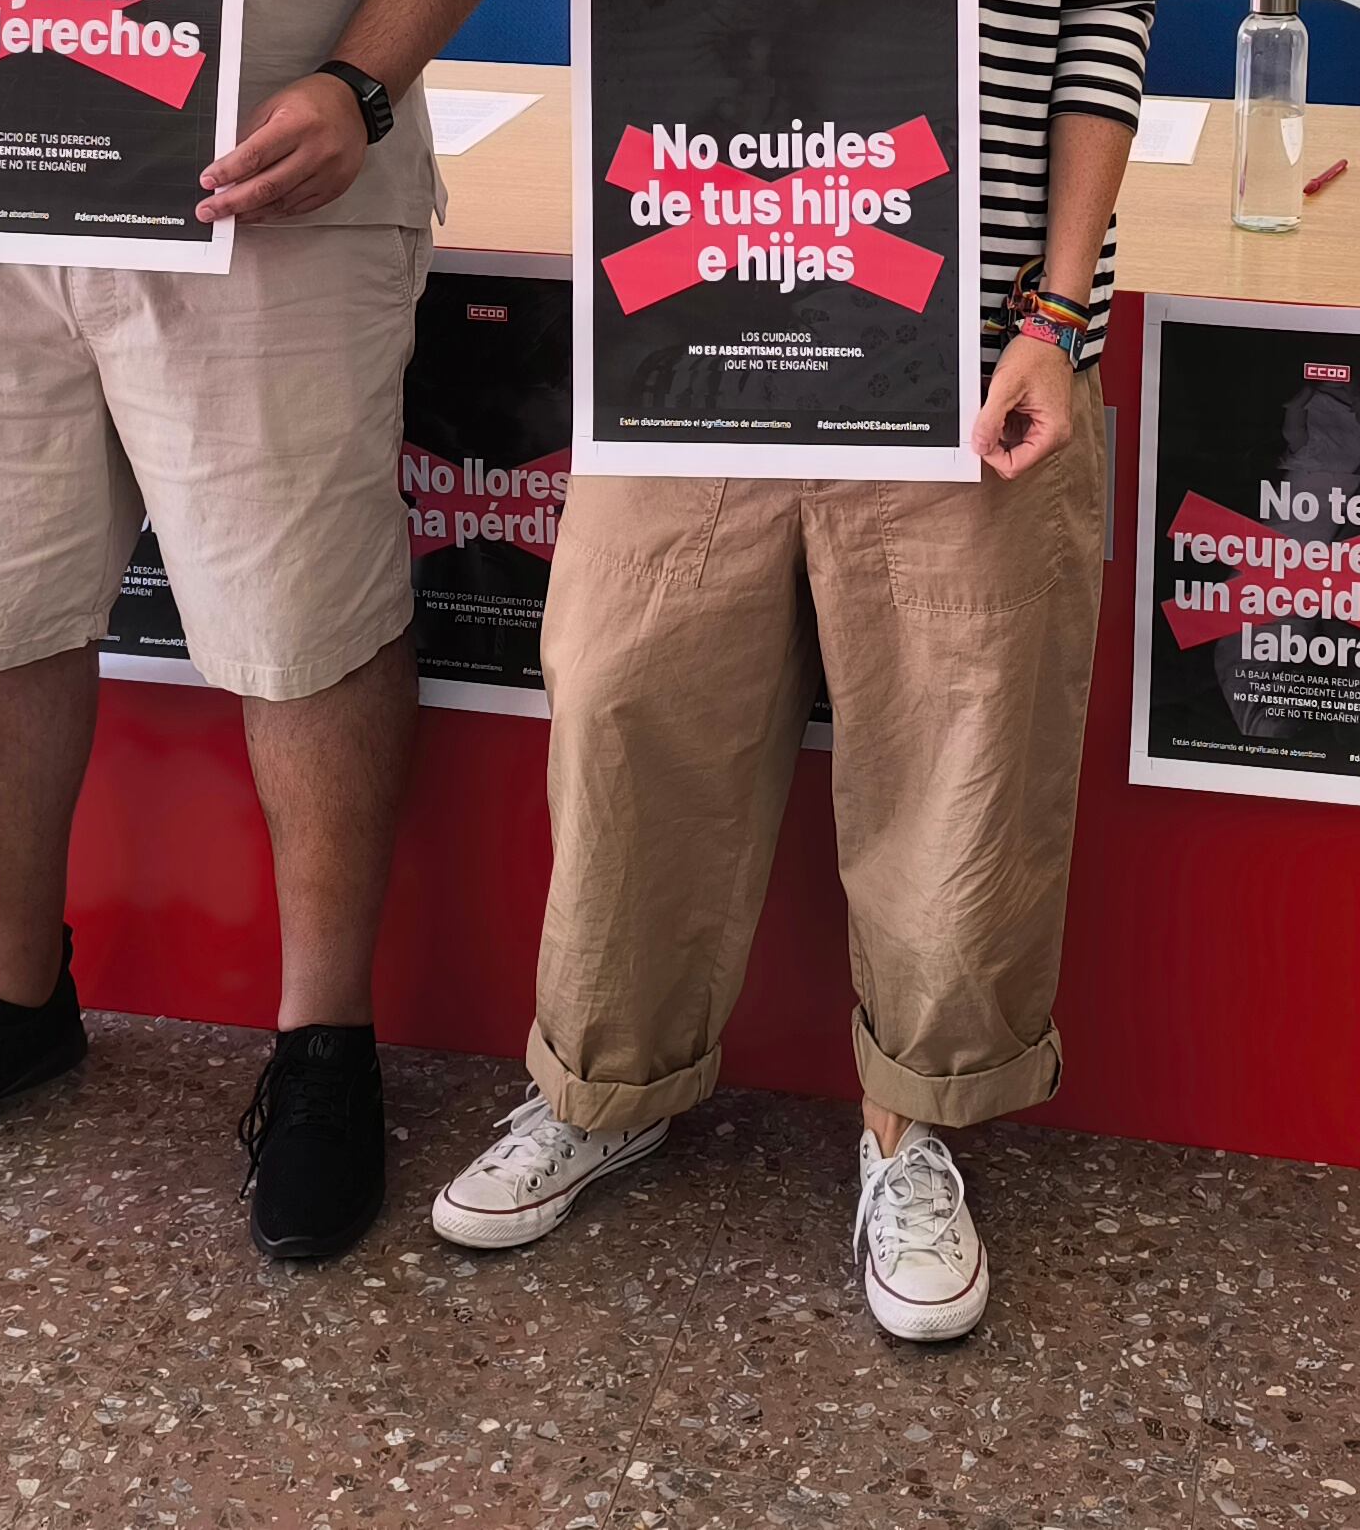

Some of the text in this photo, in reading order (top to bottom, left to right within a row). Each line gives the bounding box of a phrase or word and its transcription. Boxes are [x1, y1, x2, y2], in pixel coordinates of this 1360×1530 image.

[25, 132, 37, 143] DE
[40, 133, 58, 144] TUS
[60, 134, 111, 146] DERECHOS
[652, 119, 896, 171] No cuides
[45, 147, 57, 157] ES
[59, 148, 73, 158] UN
[74, 148, 122, 160] DERECHO.
[9, 160, 23, 170] NO
[26, 160, 37, 171] TE
[39, 159, 87, 173] ENGAÑEN!
[630, 177, 912, 237] de tus hijos
[698, 234, 855, 293] e hijas
[741, 332, 811, 343] LOS CUIDADOS
[688, 345, 865, 358] NO ES ABSENTISMO, ES UN DERECHO.
[724, 358, 829, 371] ¡QUE NO TE ENGAÑEN!
[403, 454, 571, 501] No llores
[1259, 480, 1320, 523] No
[408, 501, 555, 548] na pérdi
[423, 590, 455, 600] PERMISO
[457, 593, 472, 602] POR
[534, 599, 544, 608] DE
[1174, 578, 1230, 613] un
[426, 601, 437, 609] NO
[439, 602, 448, 610] ES
[503, 608, 513, 616] ES
[514, 609, 525, 617] UN
[474, 616, 497, 625] NO TE
[1235, 669, 1246, 678] LA
[1248, 670, 1270, 680] BAJA
[1272, 671, 1305, 683] MÉDICA
[1307, 676, 1329, 686] PARA
[1249, 682, 1271, 692] TRAS
[1273, 684, 1286, 693] UN
[1287, 685, 1336, 698] ACCIDENTE
[1233, 692, 1247, 701] NO
[1247, 693, 1259, 703] ES
[1260, 695, 1320, 710] ABSENTISMO,
[1321, 700, 1332, 709] ES
[1333, 701, 1346, 710] UN
[1265, 707, 1314, 720] ¡QUE NO TE
